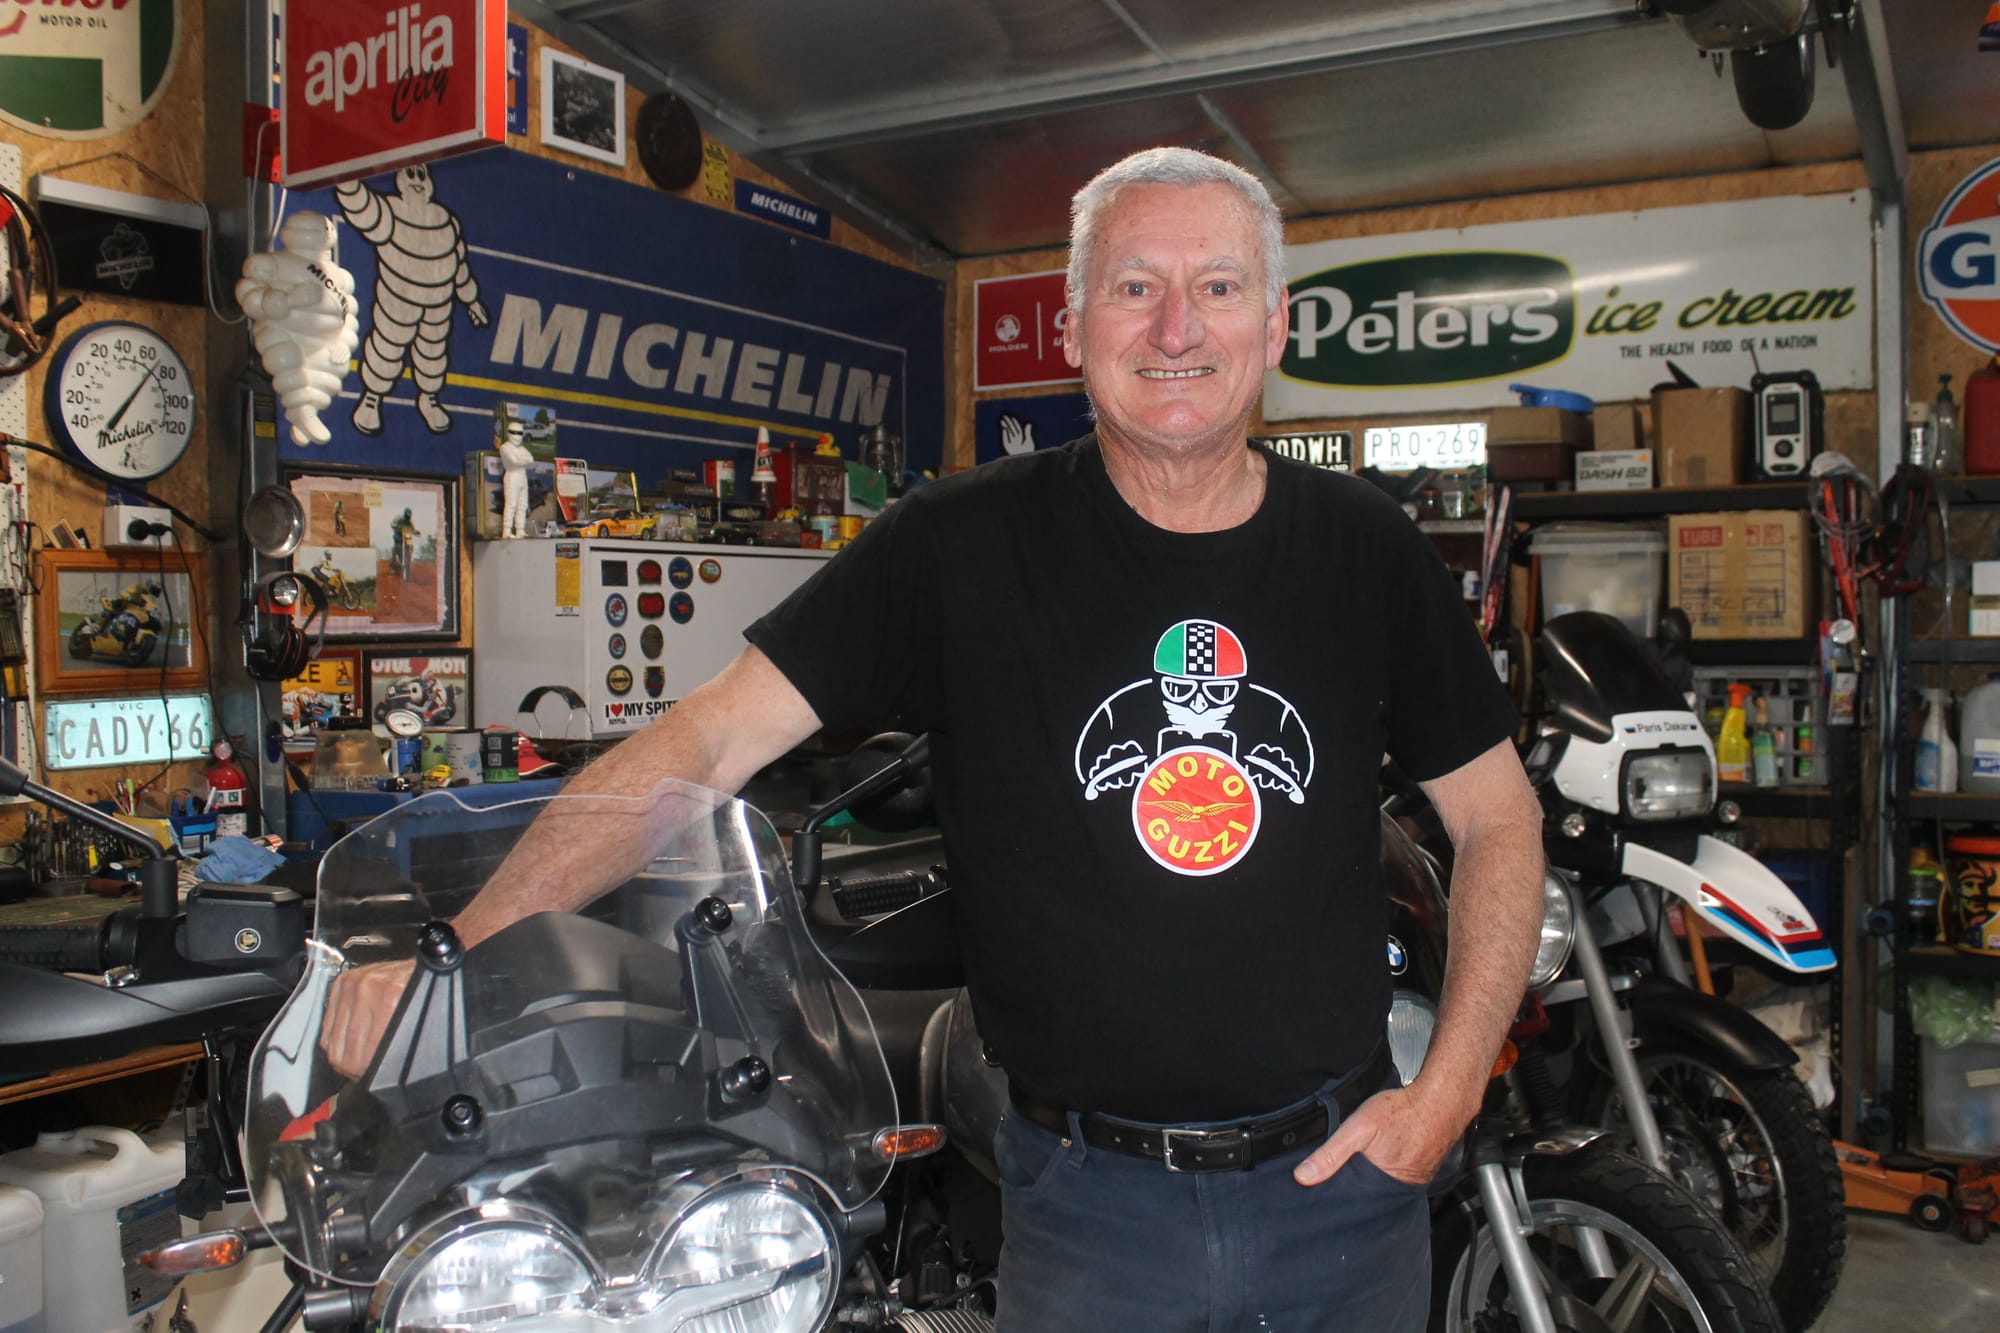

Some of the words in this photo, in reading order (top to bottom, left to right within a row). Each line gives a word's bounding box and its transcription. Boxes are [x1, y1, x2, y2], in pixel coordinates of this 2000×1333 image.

[40, 15, 82, 27] MOTOR
[88, 18, 108, 29] OIL
[304, 3, 454, 112] aprilia
[391, 64, 449, 123] City
[751, 192, 818, 224] MICHELIN
[1288, 286, 1559, 359] Peters
[1585, 286, 1663, 336] ice
[1678, 286, 1856, 330] cream
[90, 343, 108, 358] 20
[139, 345, 156, 361] 60
[114, 339, 132, 354] 40
[988, 343, 1029, 353] HOLDEN
[1620, 345, 1642, 359] THE
[1649, 342, 1694, 357] HEALTH
[1703, 339, 1733, 354] FOOD
[1741, 338, 1756, 351] OF
[1761, 337, 1769, 350] A
[1775, 335, 1818, 349] NATION
[490, 293, 892, 427] MICHELIN
[76, 362, 85, 377] 0
[159, 365, 177, 380] 80
[66, 389, 84, 404] 20
[168, 394, 189, 409] 100
[71, 414, 89, 428] 40
[166, 421, 187, 435] 120
[98, 421, 154, 448] Michelin
[1682, 529, 1721, 545] TUBE
[118, 703, 144, 711] VIC
[605, 704, 609, 718] I
[624, 702, 644, 717] MY
[1637, 722, 1662, 733] Paris
[1664, 720, 1689, 732] Dakar
[1147, 755, 1245, 798] MOTO
[1146, 817, 1249, 864] GUZZI
